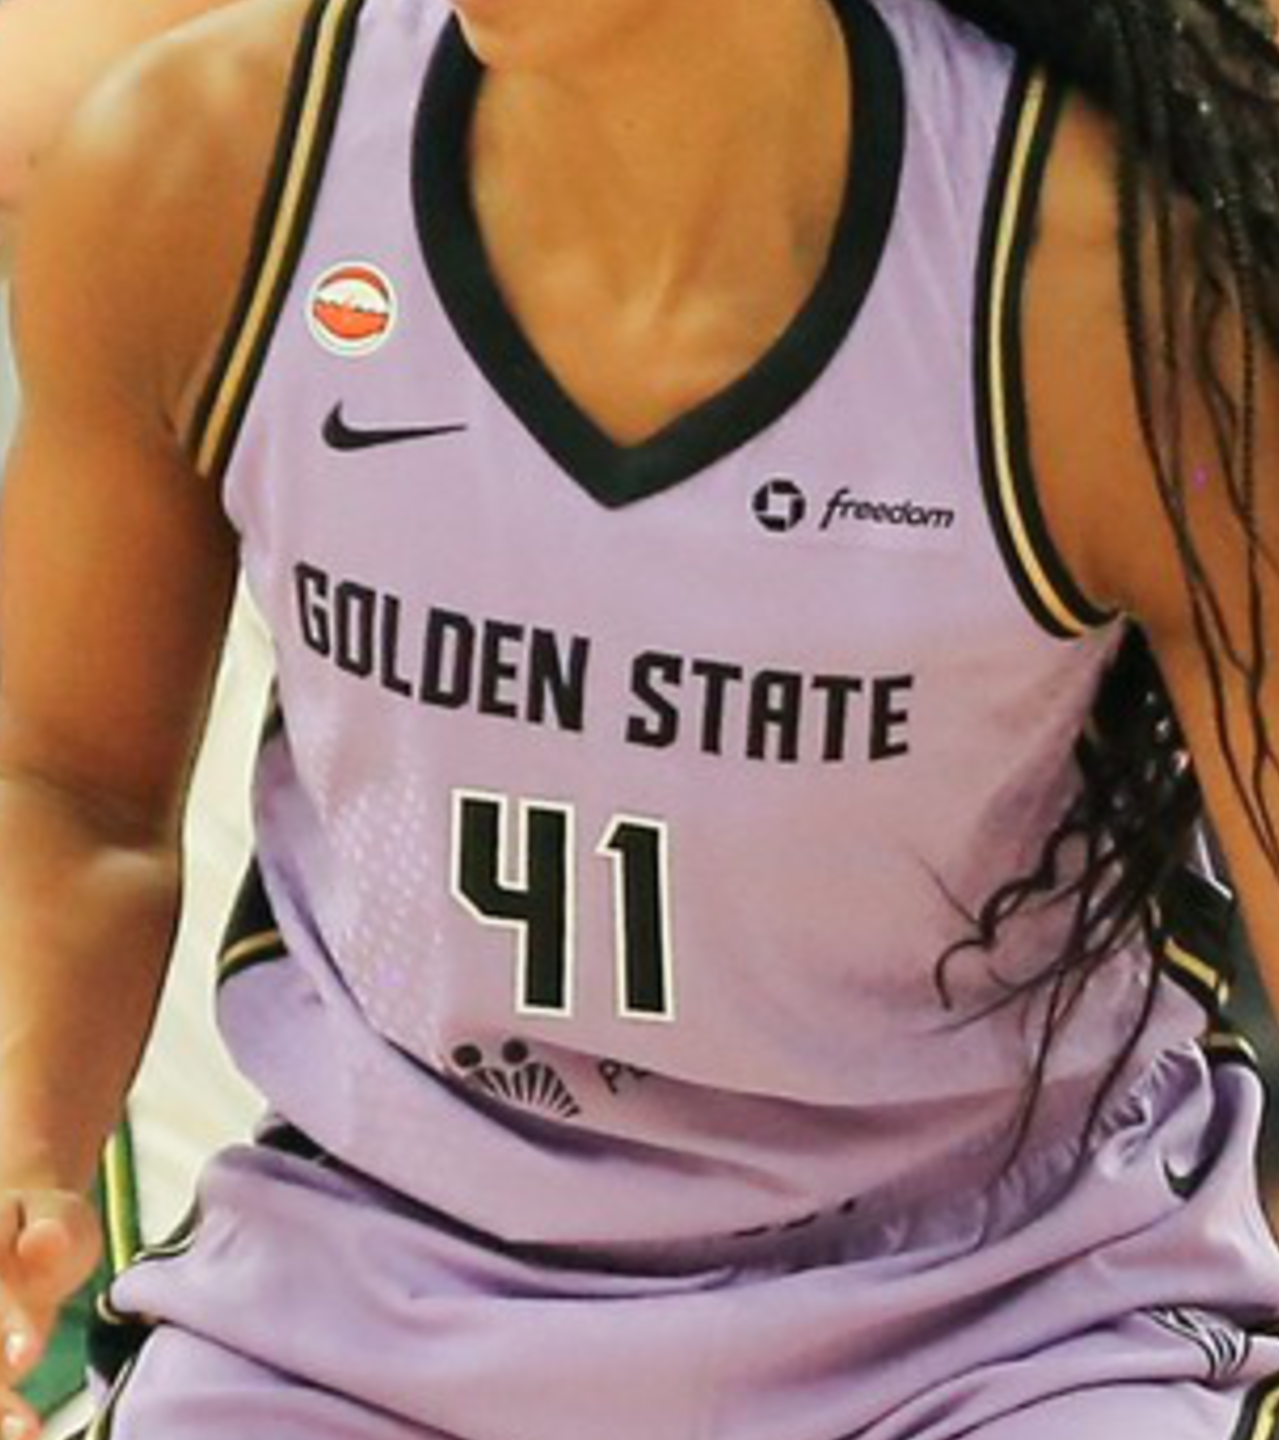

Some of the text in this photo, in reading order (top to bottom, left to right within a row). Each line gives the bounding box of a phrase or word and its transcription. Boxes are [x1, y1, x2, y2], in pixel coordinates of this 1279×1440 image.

[818, 486, 956, 532] freedom
[293, 562, 915, 763] GOLDEN STATE
[451, 788, 675, 1023] 41
